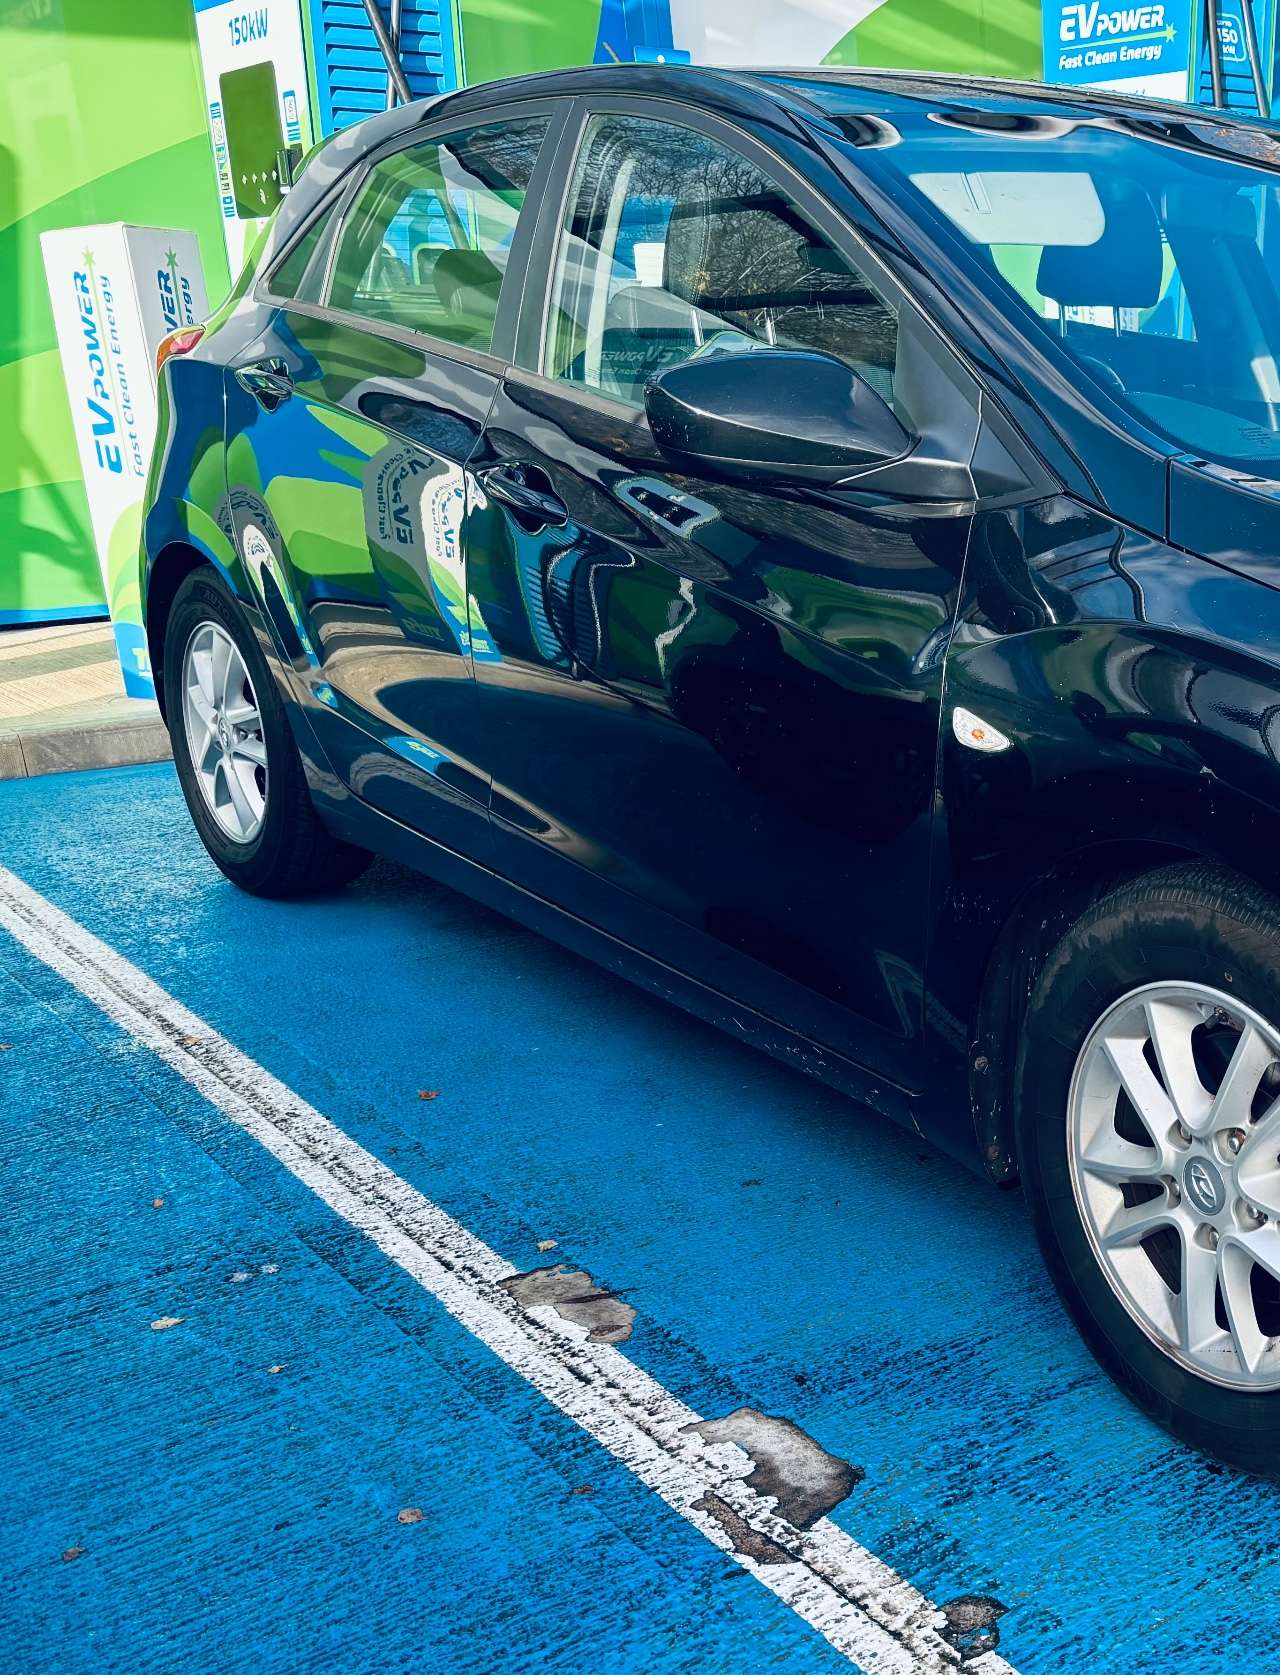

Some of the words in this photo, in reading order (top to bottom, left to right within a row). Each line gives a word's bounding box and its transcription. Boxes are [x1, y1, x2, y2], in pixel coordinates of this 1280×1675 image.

[228, 8, 268, 46] 150kW
[1059, 54, 1082, 71] Fast
[1085, 47, 1117, 67] Clean
[1119, 44, 1162, 62] Energy
[100, 275, 123, 355] Energy
[116, 364, 136, 427] Clean
[129, 431, 146, 479] Fast
